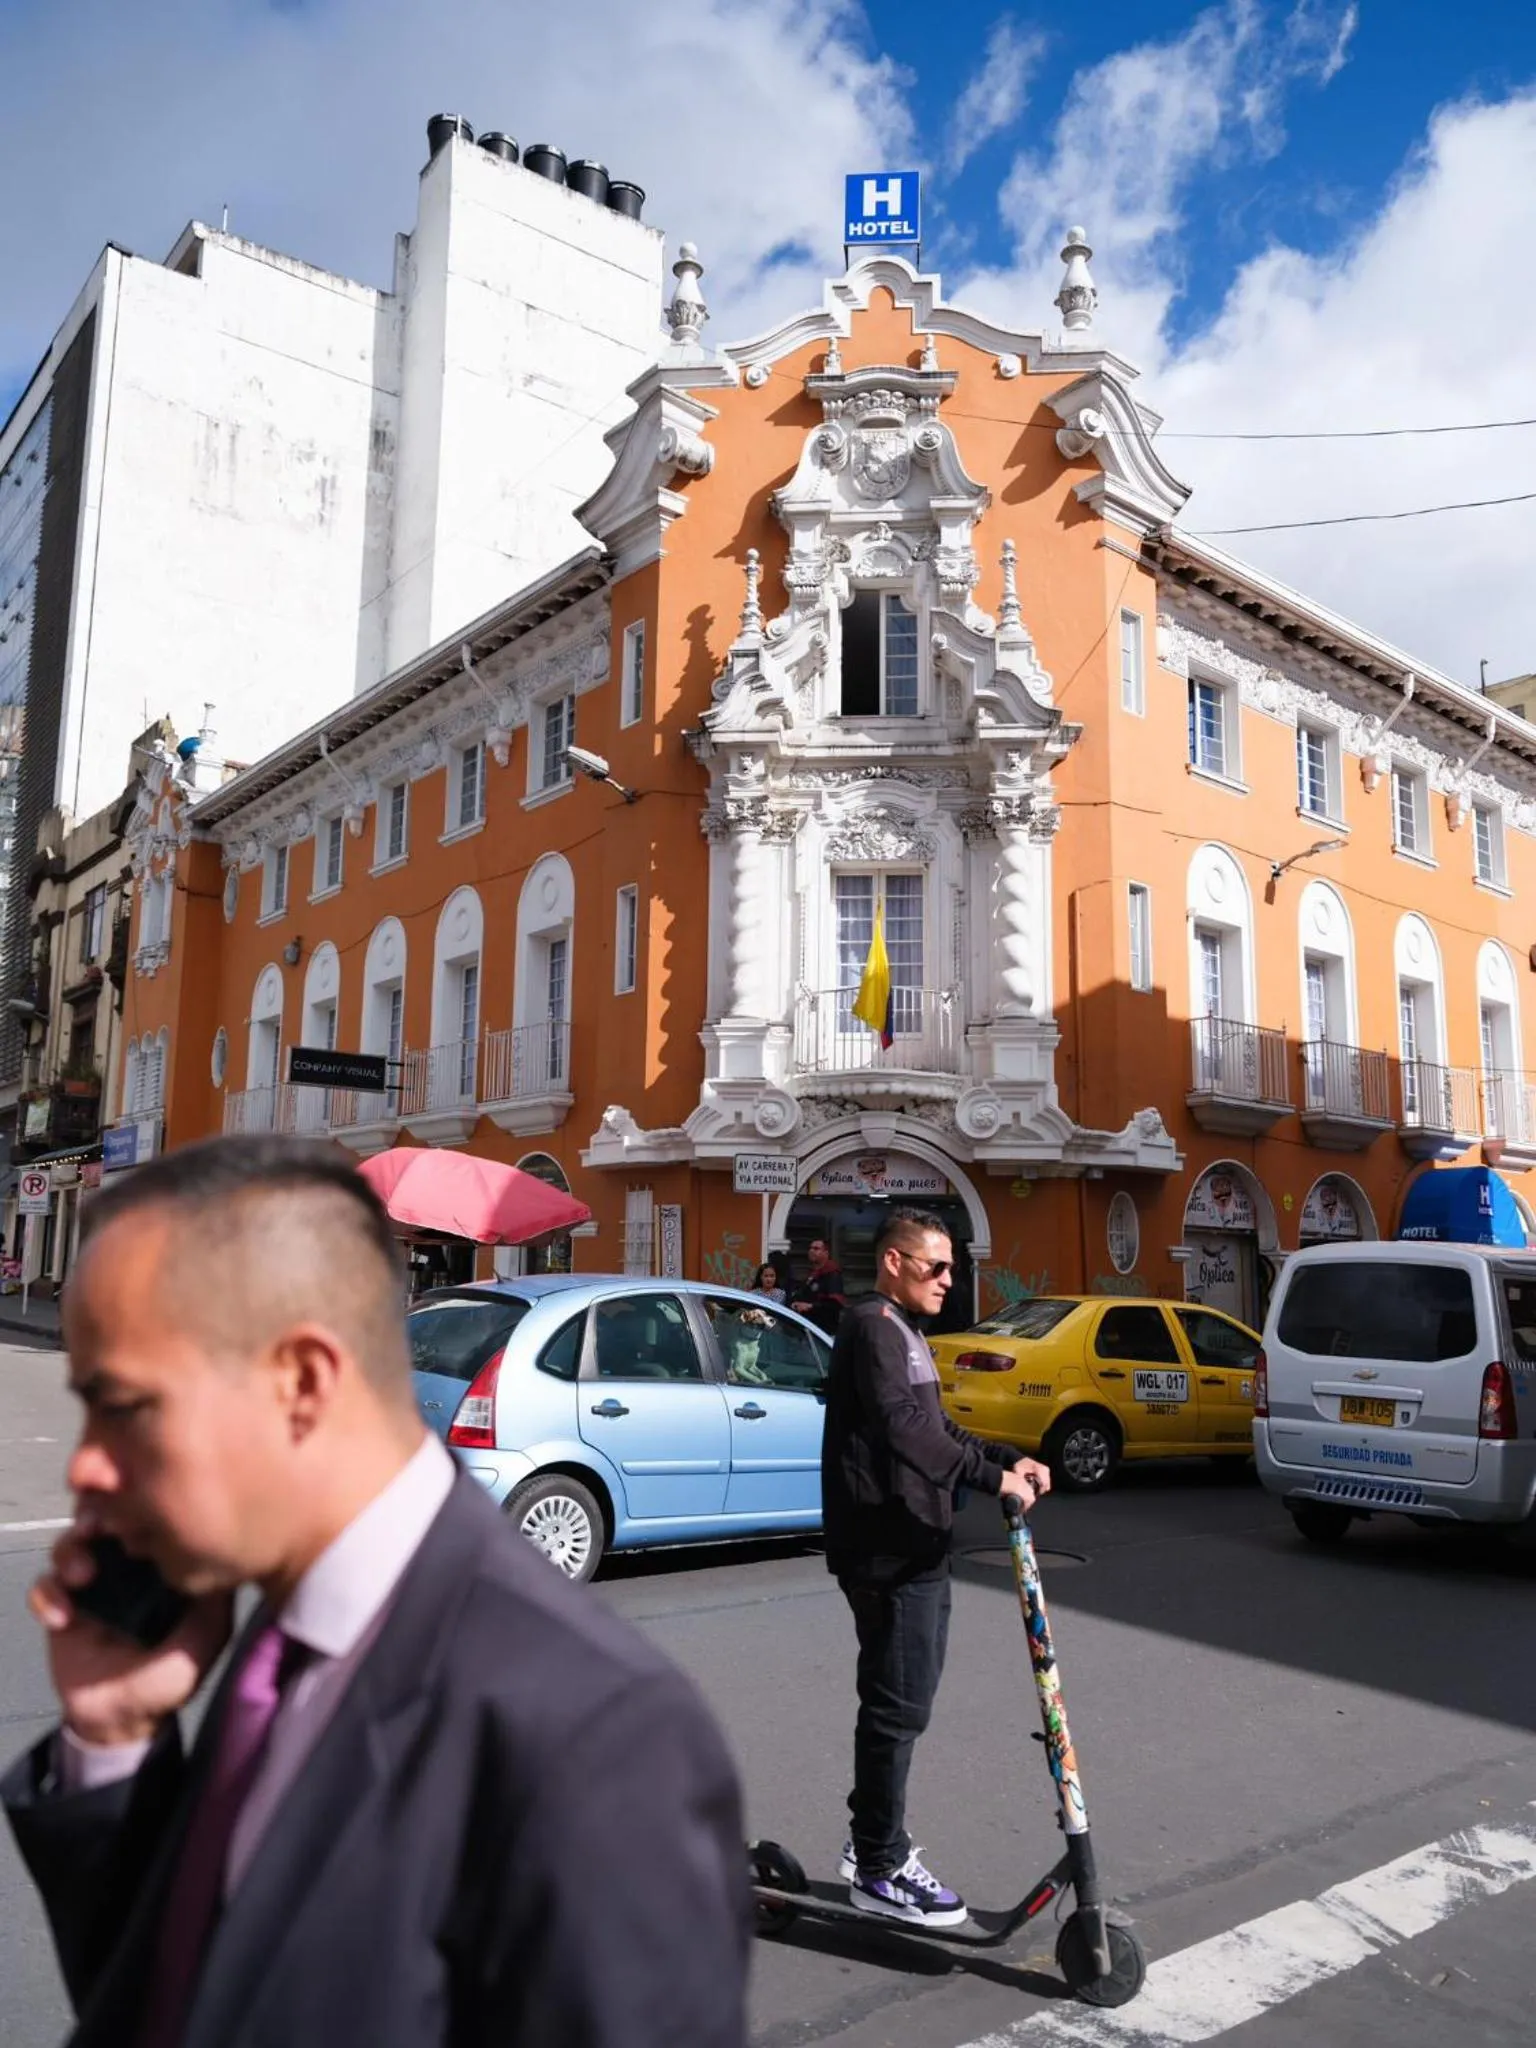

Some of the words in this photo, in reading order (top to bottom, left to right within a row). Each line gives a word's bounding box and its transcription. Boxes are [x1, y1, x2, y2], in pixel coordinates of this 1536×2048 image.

[863, 178, 902, 216] H
[848, 220, 915, 236] HOTEL
[293, 1060, 341, 1073] COMPANY
[738, 1160, 749, 1169] AV
[751, 1161, 787, 1171] CARRERA
[789, 1162, 795, 1171] 7
[753, 1175, 793, 1186] PEATONAL
[1480, 1185, 1491, 1205] H
[1402, 1226, 1438, 1239] HOTEL
[664, 1218, 677, 1278] OPTIC
[1136, 1373, 1160, 1389] WGL
[1166, 1374, 1185, 1390] 017
[1322, 1444, 1371, 1462] SEGURIDAD
[1372, 1450, 1413, 1467] PRIVADA
